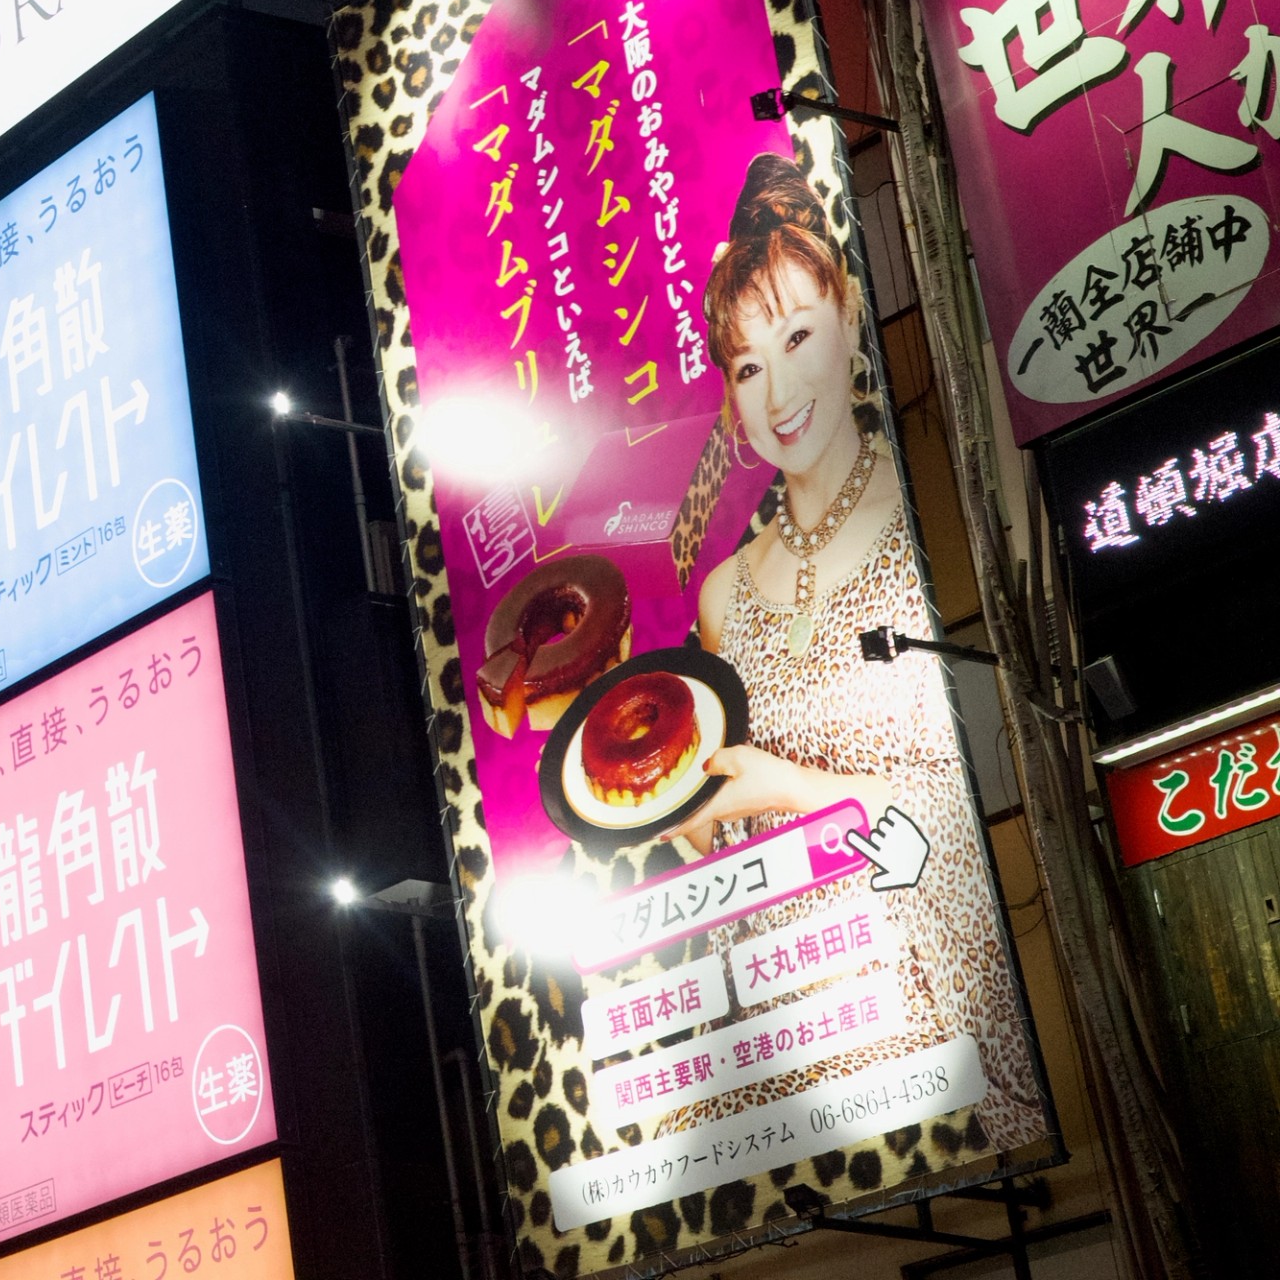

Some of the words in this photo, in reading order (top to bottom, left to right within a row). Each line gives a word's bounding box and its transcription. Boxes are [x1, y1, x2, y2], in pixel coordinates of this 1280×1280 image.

[519, 66, 594, 404] マダムシンコといえば
[618, 0, 707, 387] 大阪のおみやげといえば
[1017, 205, 1252, 375] 一蘭全店舗中
[1075, 293, 1217, 394] 世界一
[59, 536, 93, 567] ミント
[97, 516, 127, 546] 16包
[138, 500, 193, 567] 生薬
[617, 520, 669, 535] SHINCO
[623, 510, 673, 522] MADAME
[610, 857, 769, 945] マダムシンコ
[745, 913, 873, 991] 大丸梅田店
[606, 978, 703, 1040] 箕面本店
[615, 994, 881, 1110] 関西主要駅・空港のお土産店
[20, 1081, 104, 1143] スティック
[112, 1070, 149, 1102] ピーチ
[154, 1056, 184, 1085] 16包
[198, 1052, 258, 1117] 生薬
[581, 1122, 797, 1207] (株)カウカウフードシステム
[809, 1066, 951, 1135] 06-6864-4538
